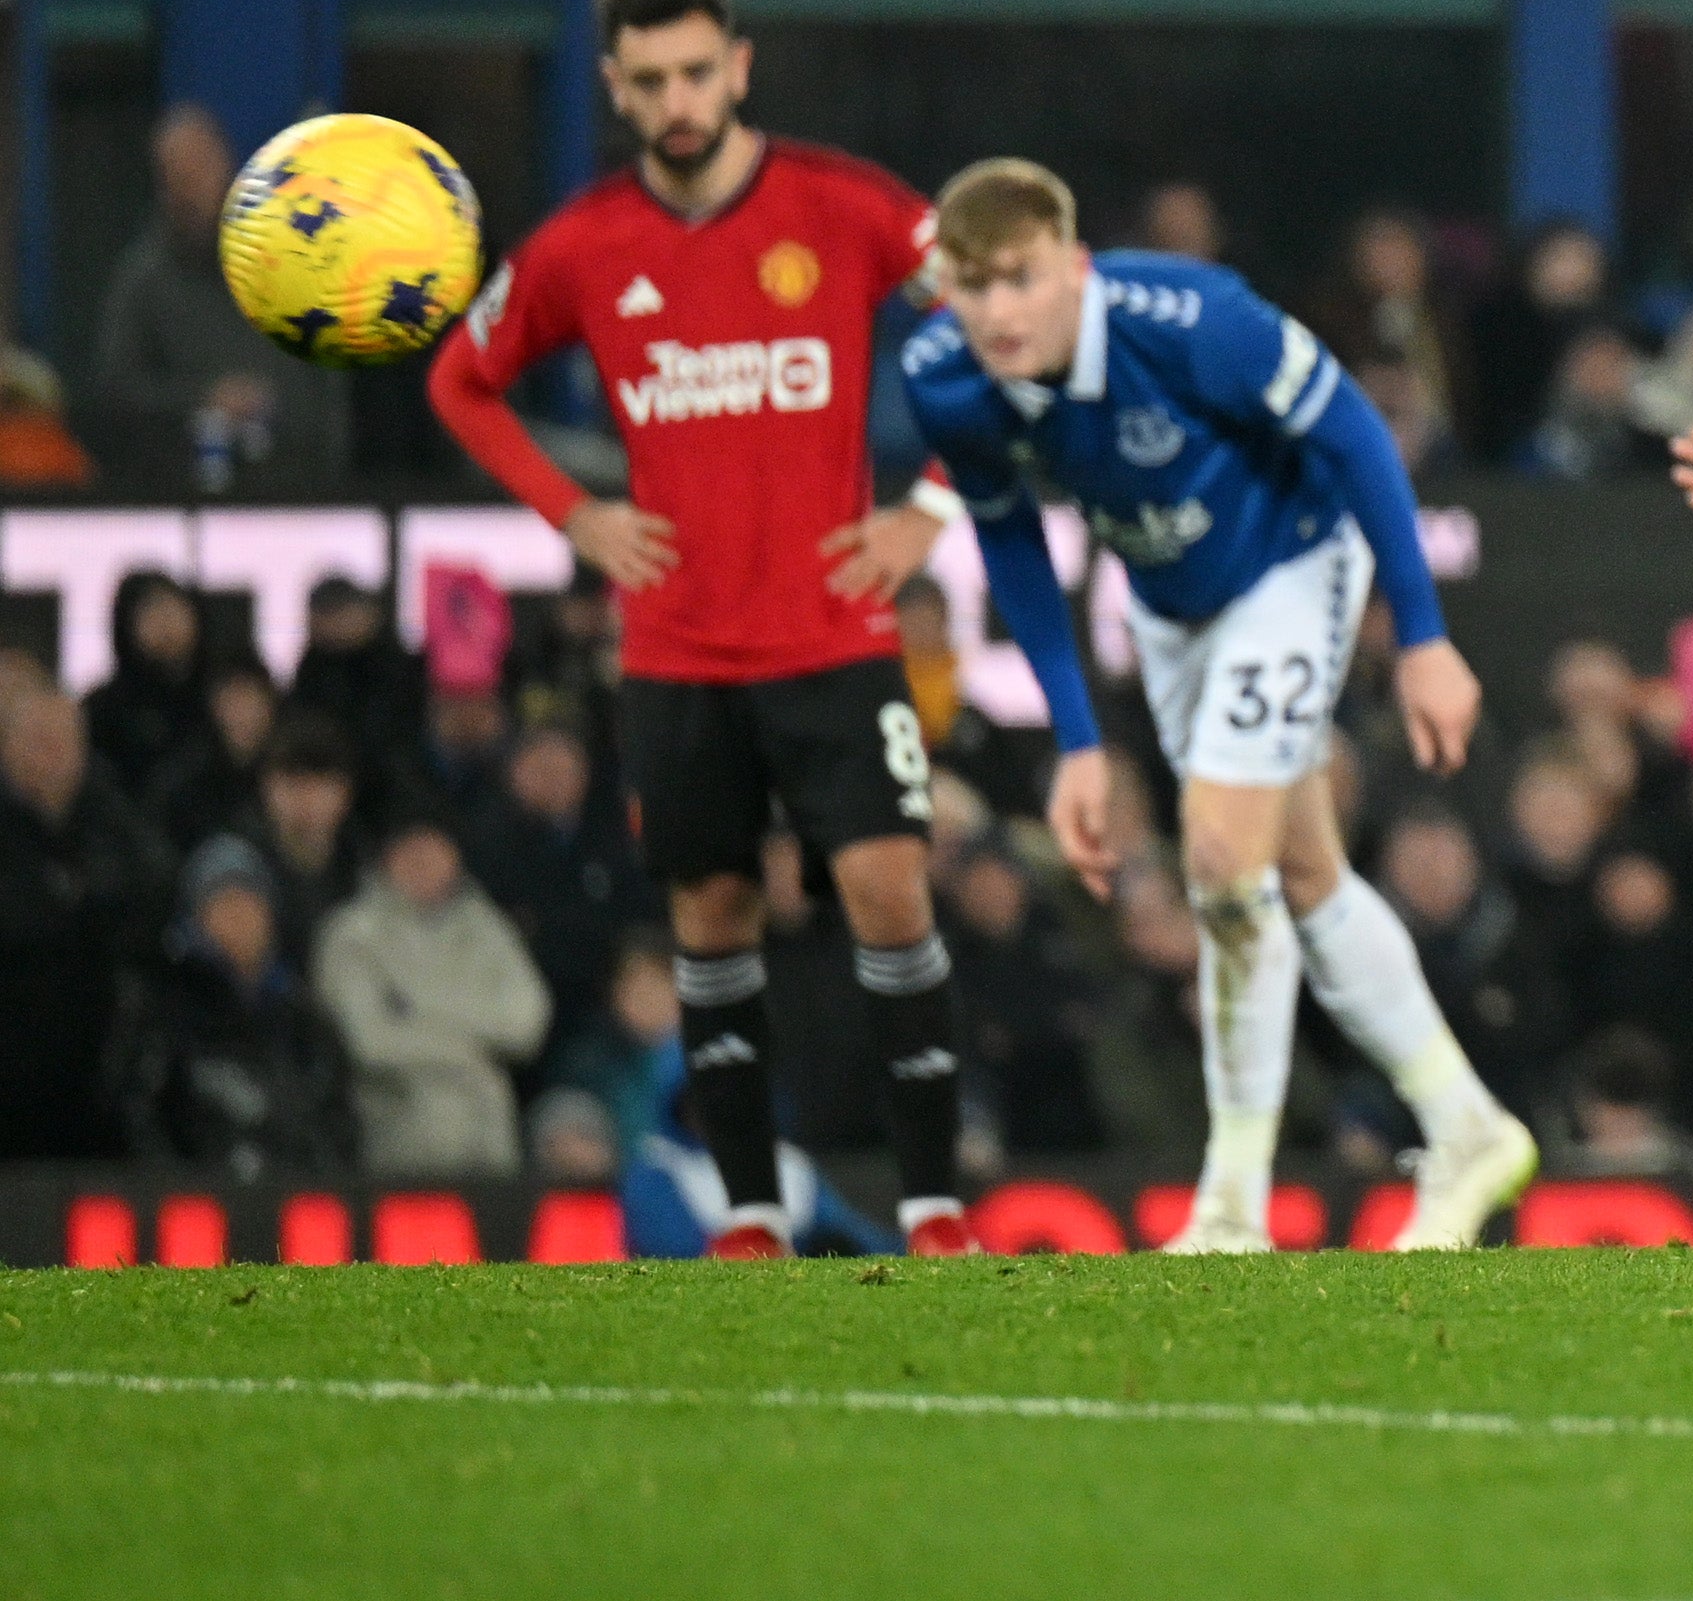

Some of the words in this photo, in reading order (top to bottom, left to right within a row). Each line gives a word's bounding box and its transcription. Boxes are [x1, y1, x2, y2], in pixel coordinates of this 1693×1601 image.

[645, 338, 767, 390] Team
[617, 376, 766, 428] Viewer
[1227, 647, 1316, 732] 32
[876, 702, 931, 789] 8
